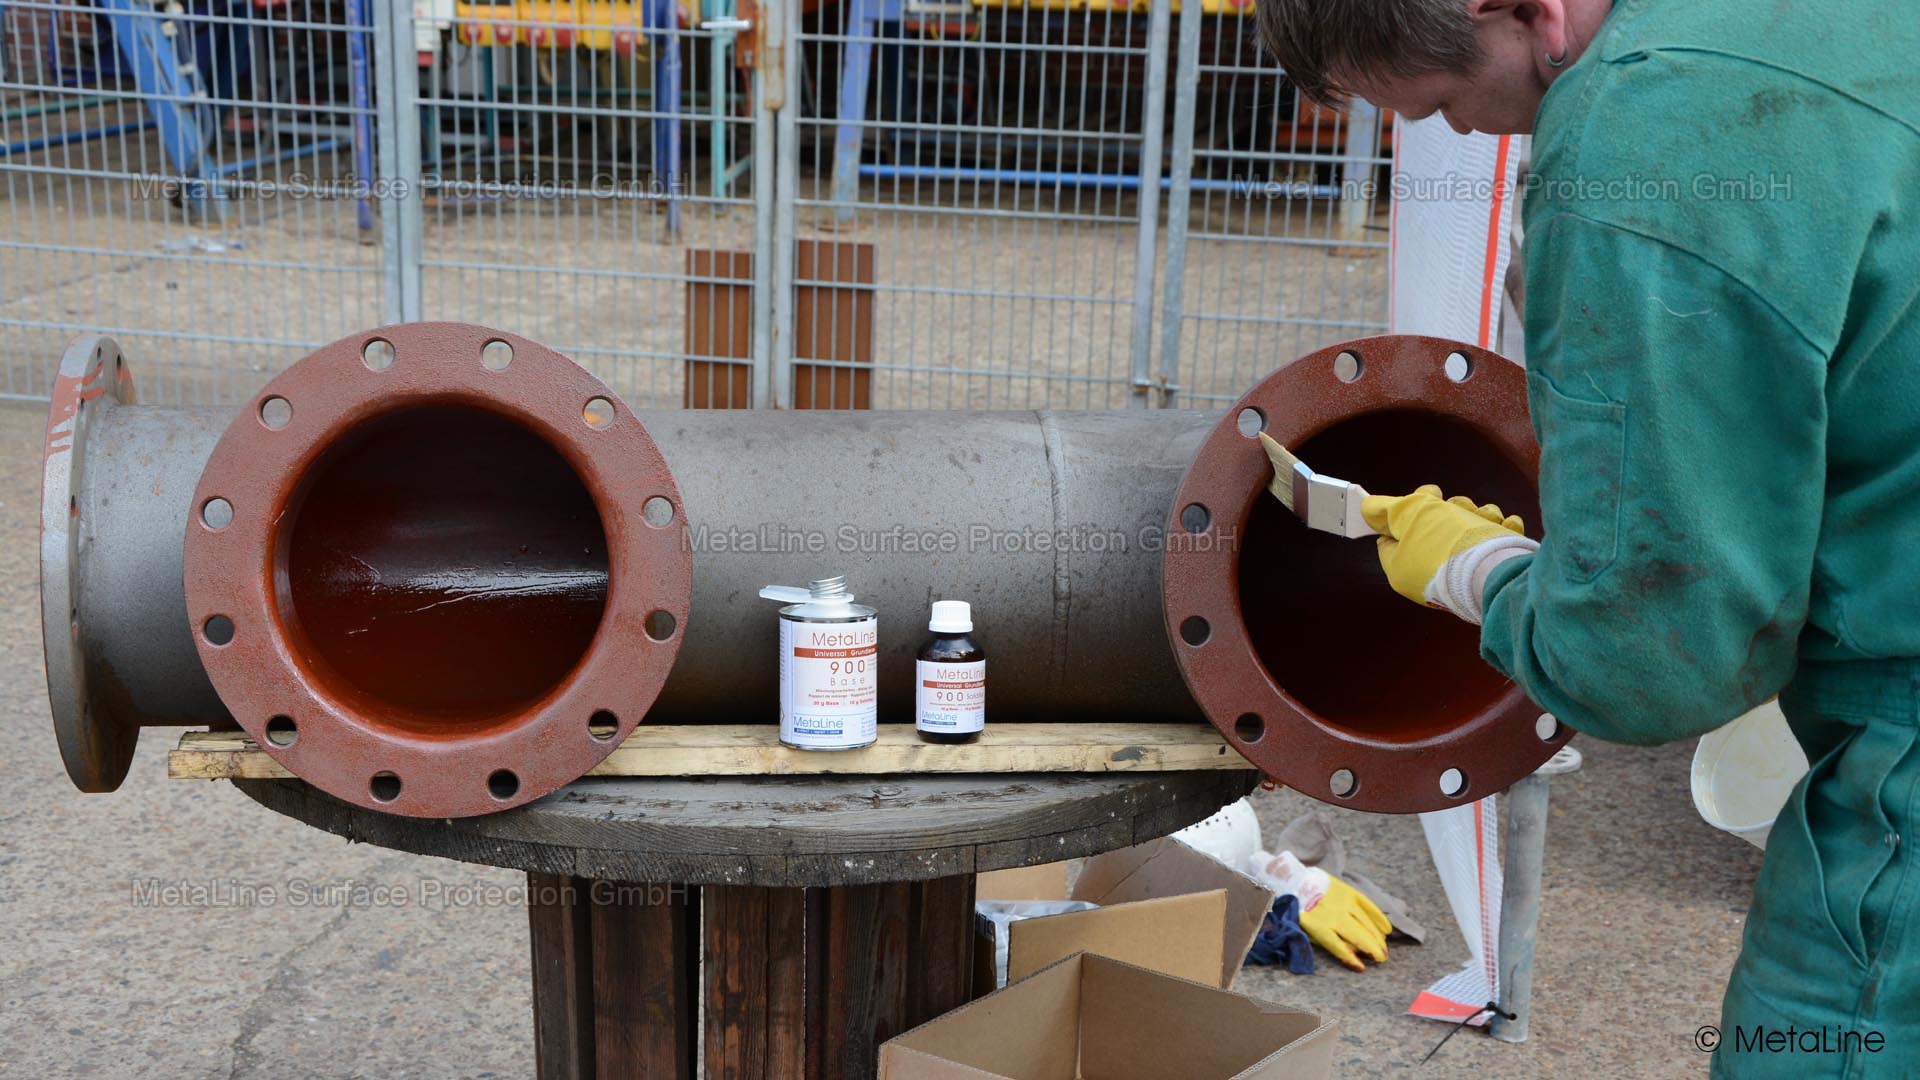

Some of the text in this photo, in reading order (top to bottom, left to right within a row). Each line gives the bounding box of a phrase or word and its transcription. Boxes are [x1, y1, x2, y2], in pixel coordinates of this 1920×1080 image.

[812, 630, 876, 647] MetaLine
[830, 659, 865, 675] 900
[830, 677, 865, 686] Base
[936, 691, 963, 702] 900
[794, 716, 843, 728] MetaLine
